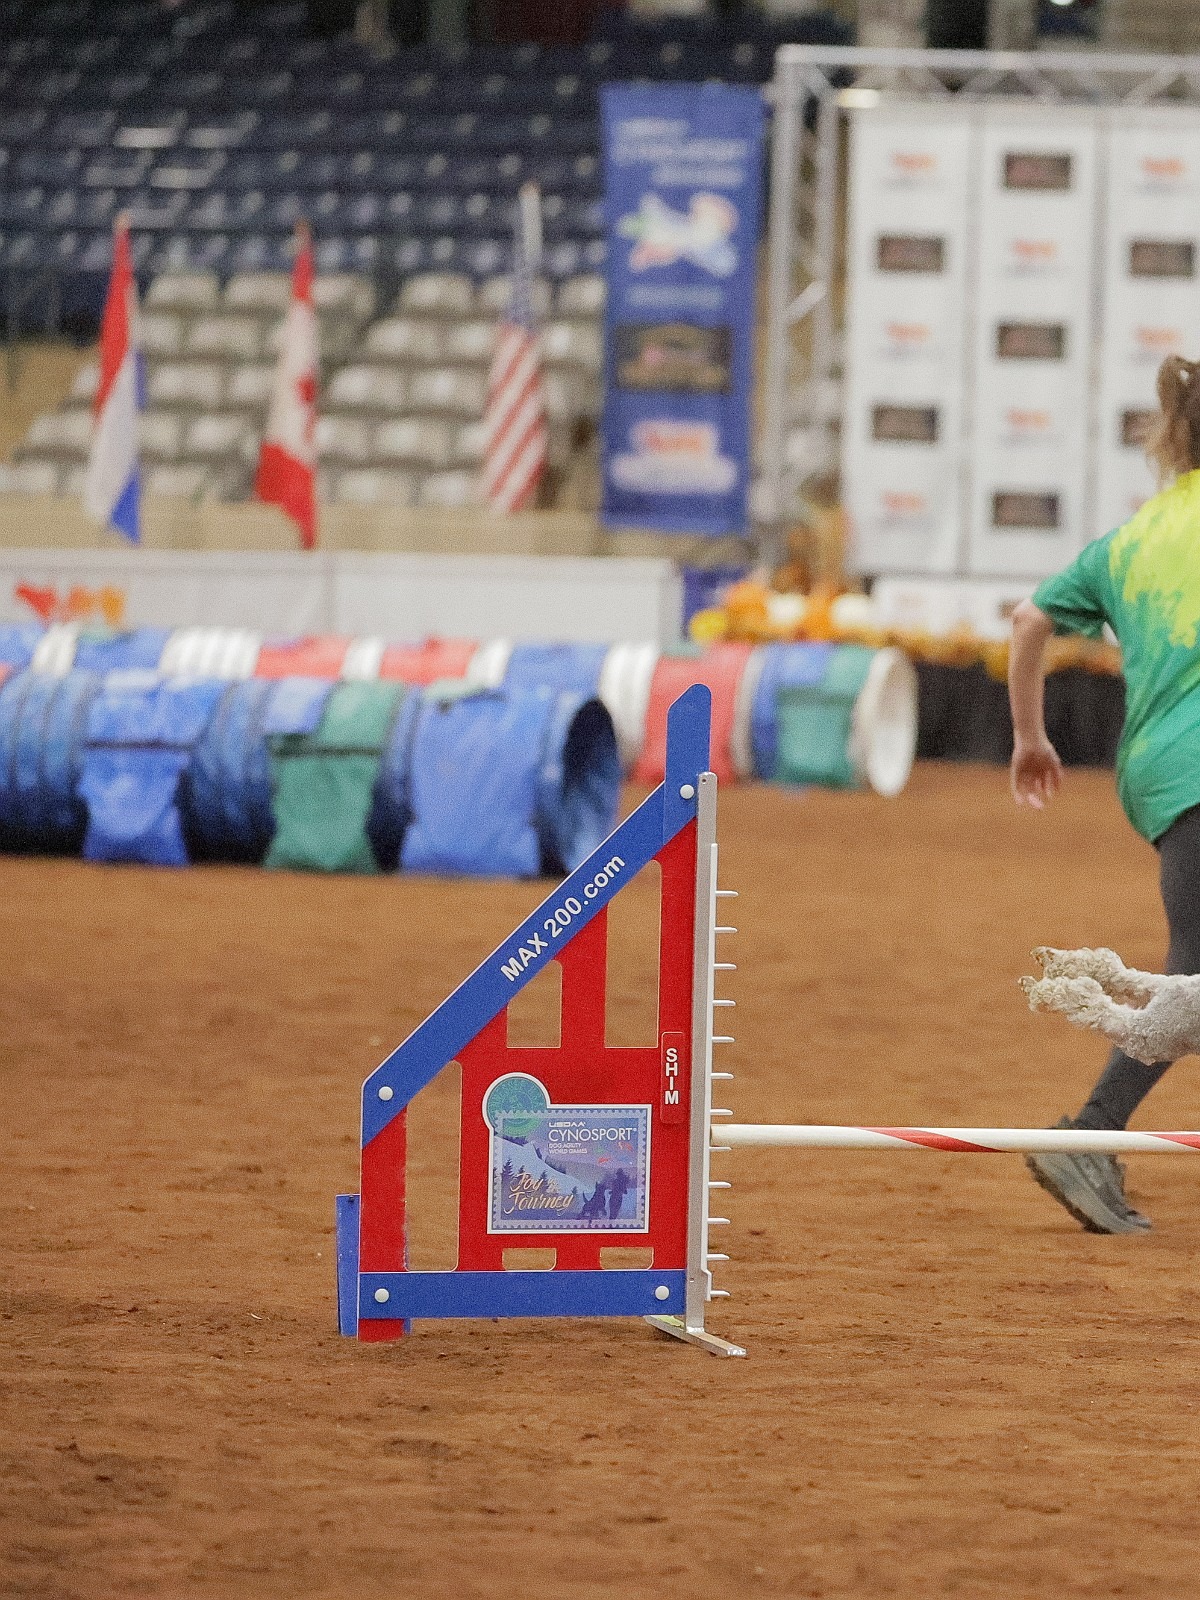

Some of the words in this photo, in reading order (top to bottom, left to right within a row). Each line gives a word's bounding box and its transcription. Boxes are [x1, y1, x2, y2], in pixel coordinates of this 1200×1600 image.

[500, 932, 549, 982] MAX
[543, 856, 626, 938] 200.com
[664, 1047, 679, 1105] SHIM
[548, 1127, 633, 1142] CYNOSPORT
[509, 1172, 545, 1194] Joy
[503, 1191, 574, 1217] Journey
